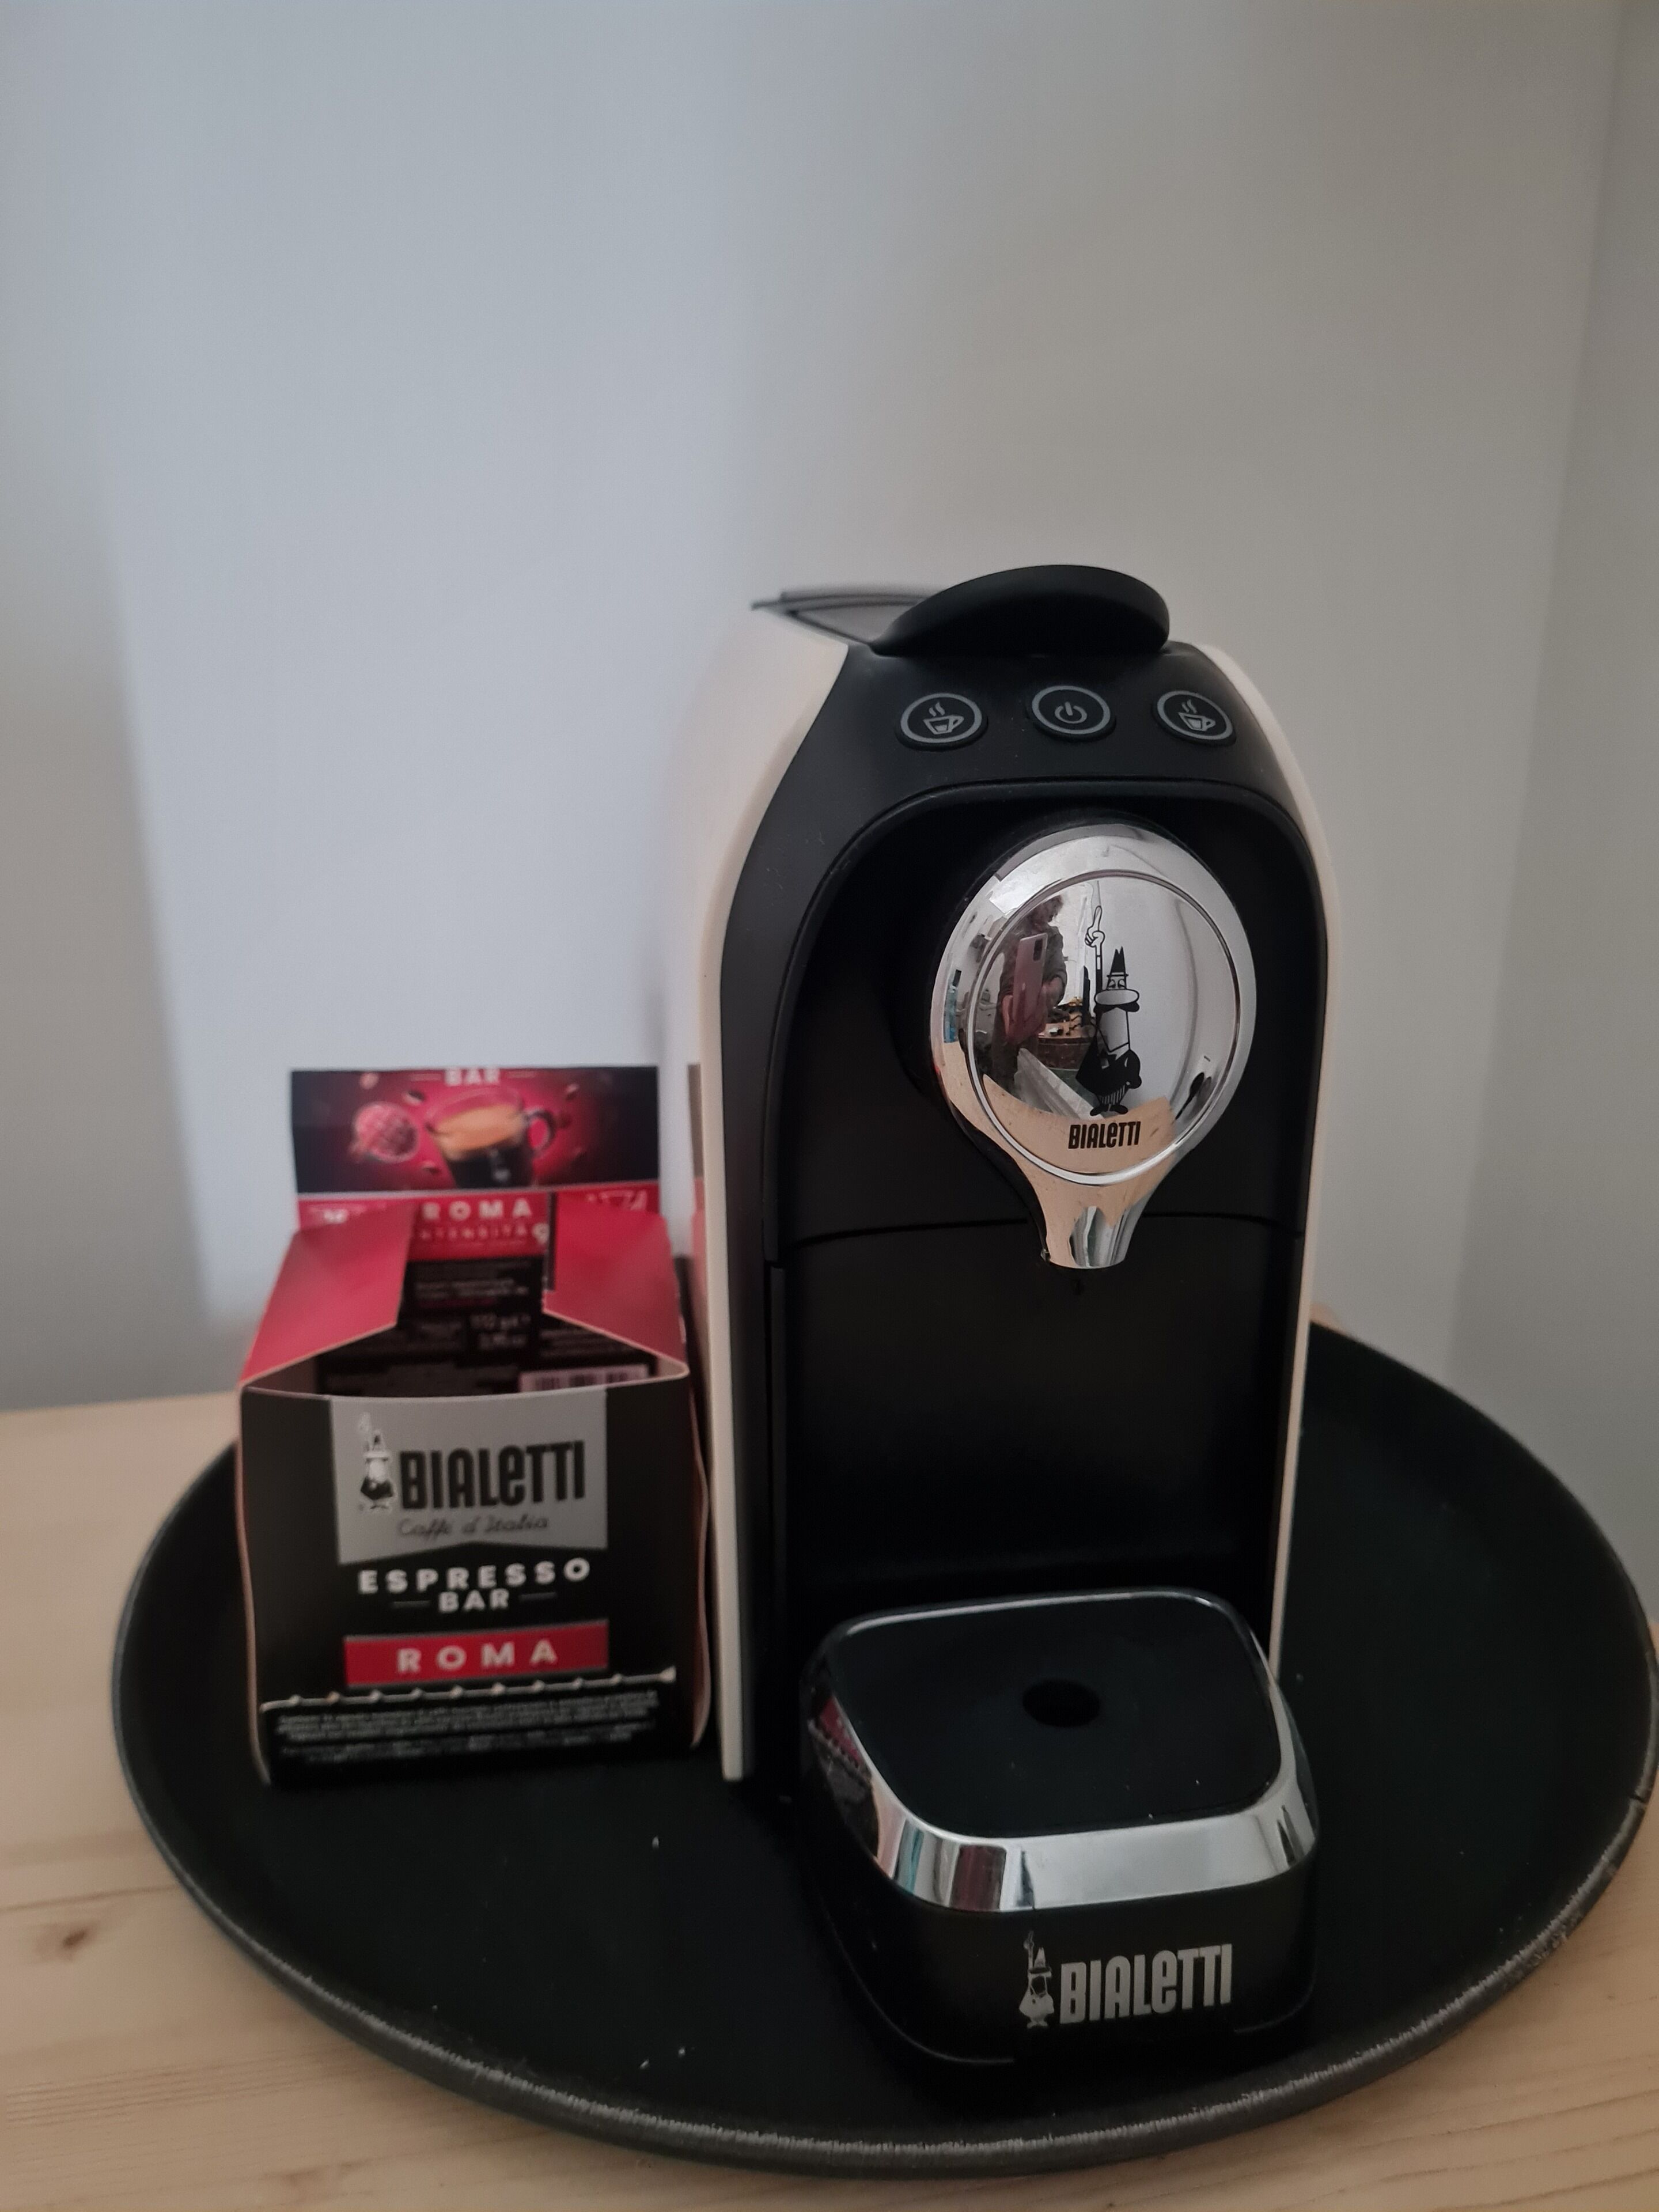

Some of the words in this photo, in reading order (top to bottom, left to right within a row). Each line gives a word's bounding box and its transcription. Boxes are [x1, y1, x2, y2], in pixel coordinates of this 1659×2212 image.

[421, 1198, 533, 1221] ROMA
[357, 1556, 591, 1594] ESPRESSO
[437, 1588, 510, 1613] BAR
[396, 1638, 558, 1674] ROMA
